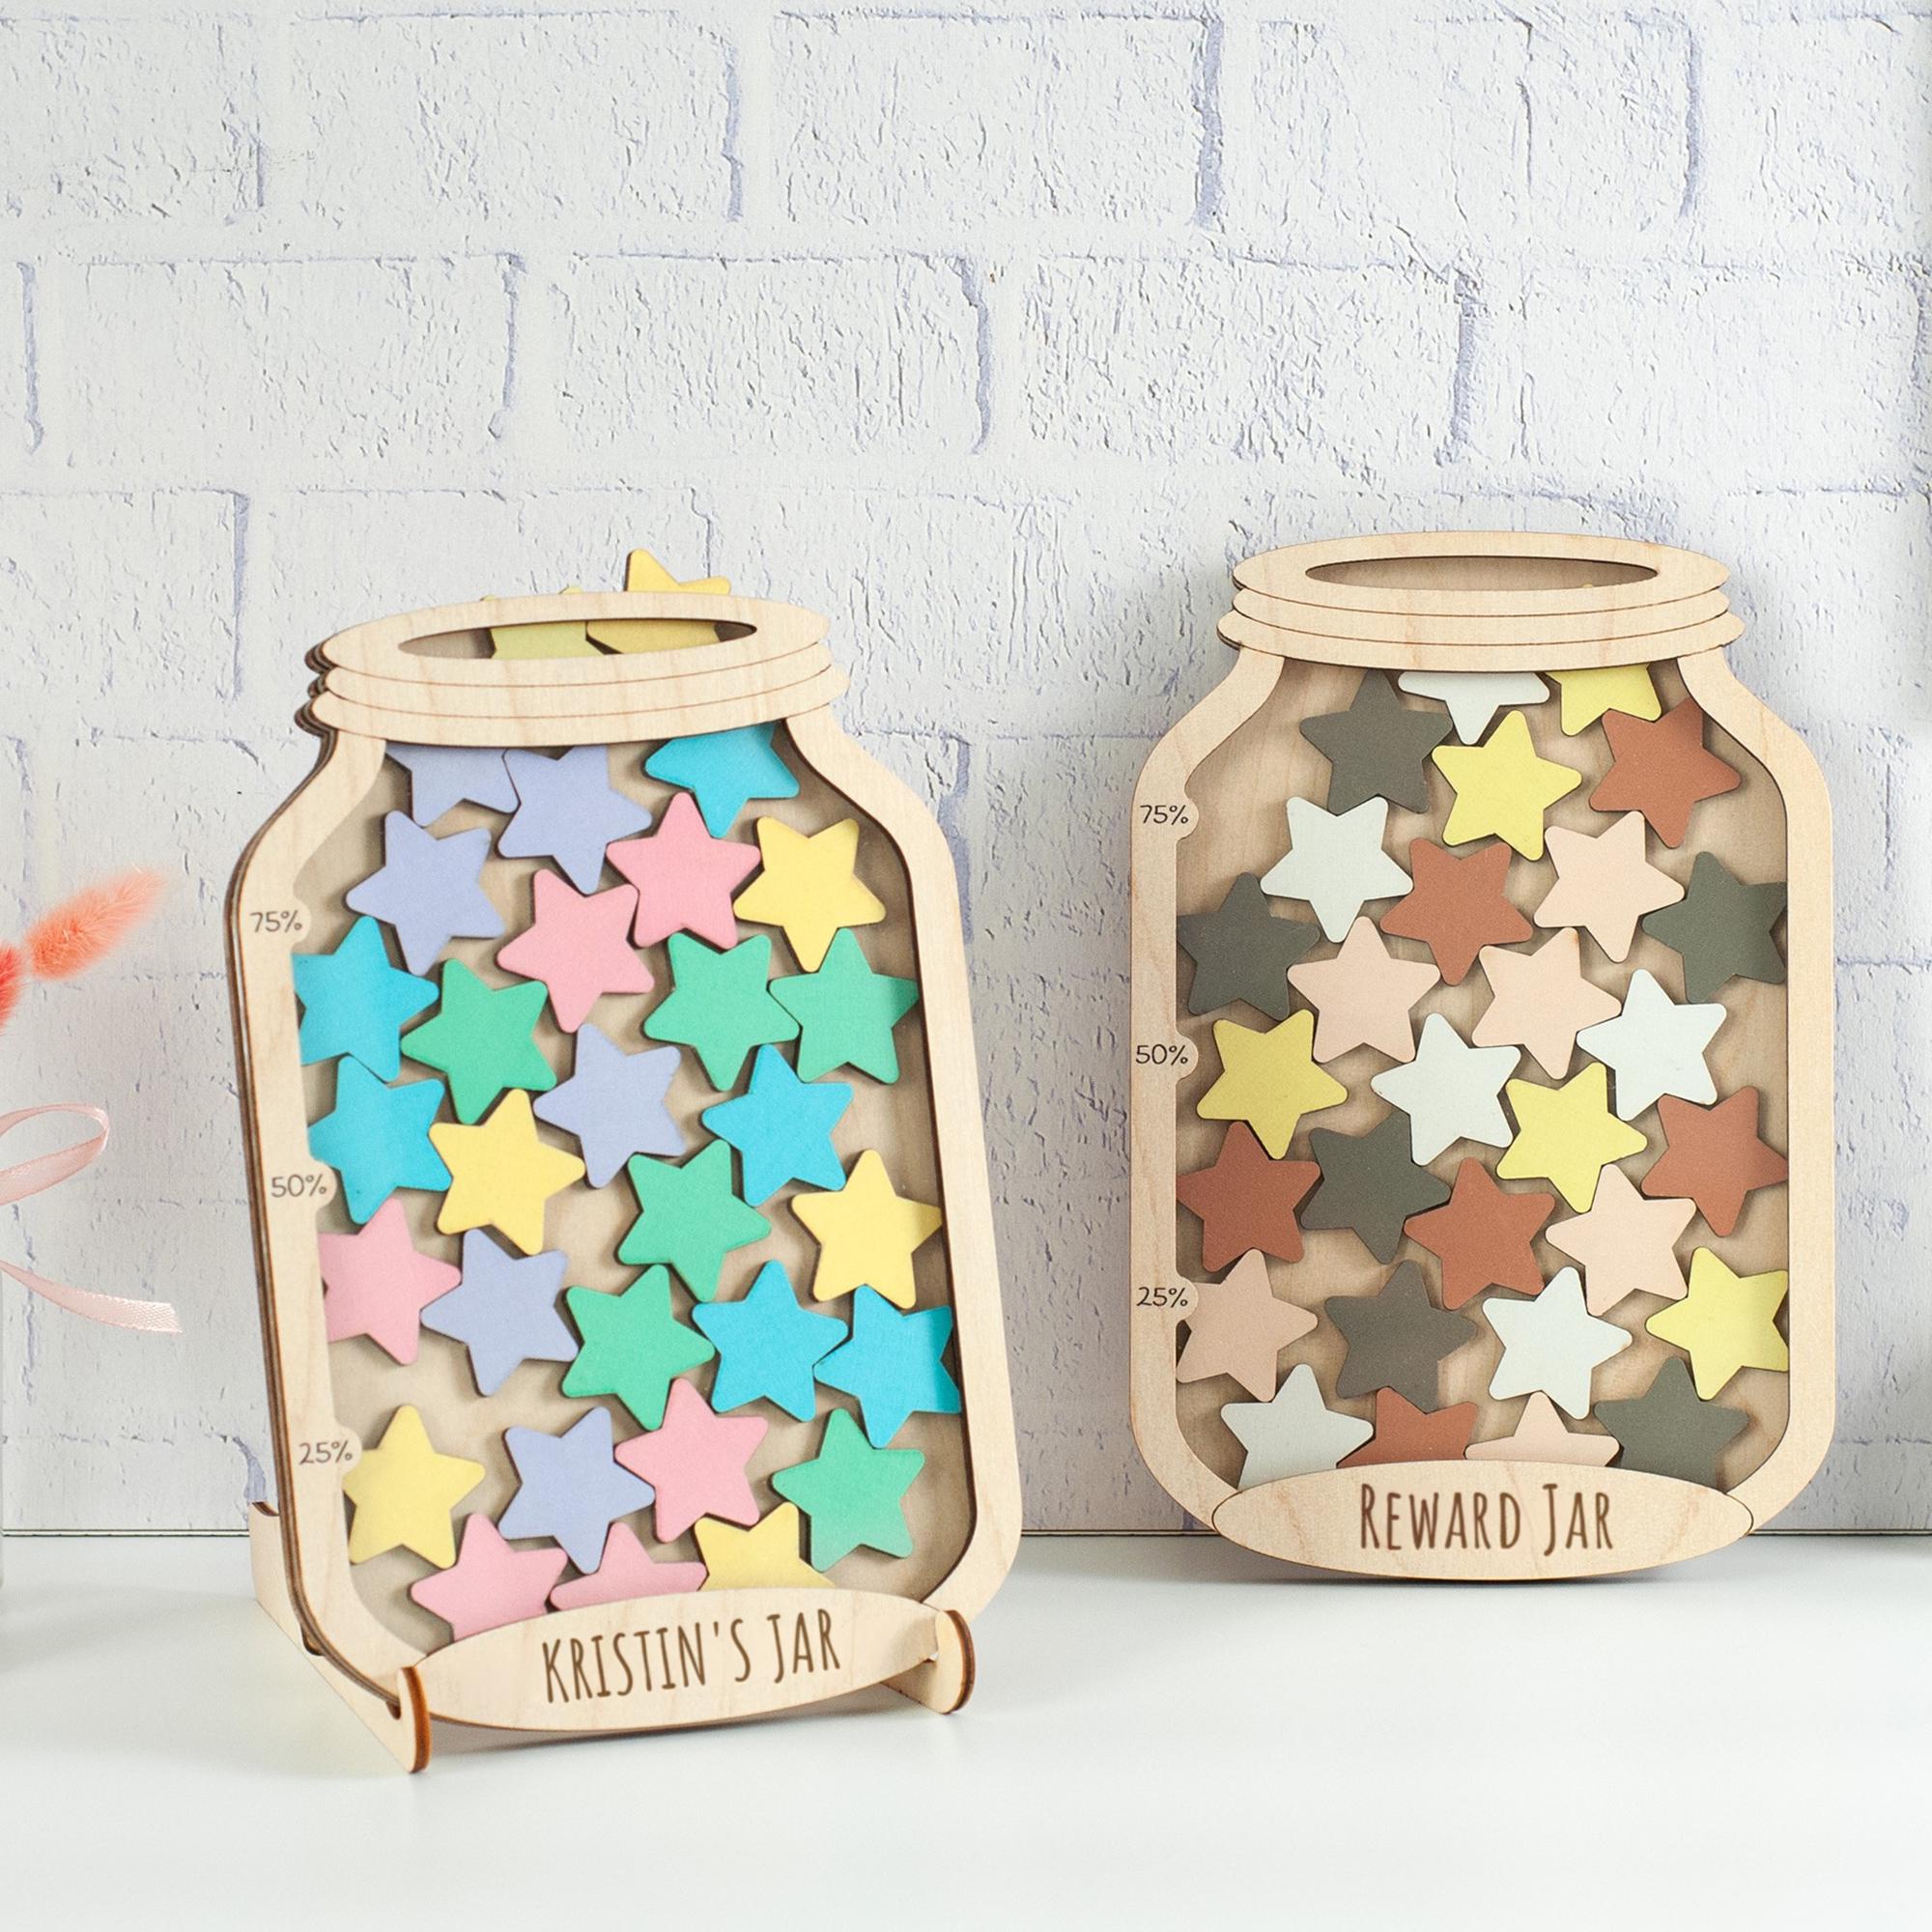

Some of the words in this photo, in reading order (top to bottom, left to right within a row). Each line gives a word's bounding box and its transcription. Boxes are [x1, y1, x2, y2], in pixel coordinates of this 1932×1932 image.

[1139, 804, 1189, 826] 75%
[250, 910, 302, 932] 75%
[1135, 1043, 1189, 1066] 50%
[271, 1173, 327, 1198] 50%
[1136, 1286, 1189, 1309] 25%
[298, 1440, 353, 1465] 25%
[1360, 1483, 1521, 1551] REWARD
[1542, 1483, 1613, 1557] JAR
[542, 1618, 752, 1704] KRISTIN'S
[766, 1608, 840, 1684] JAR
